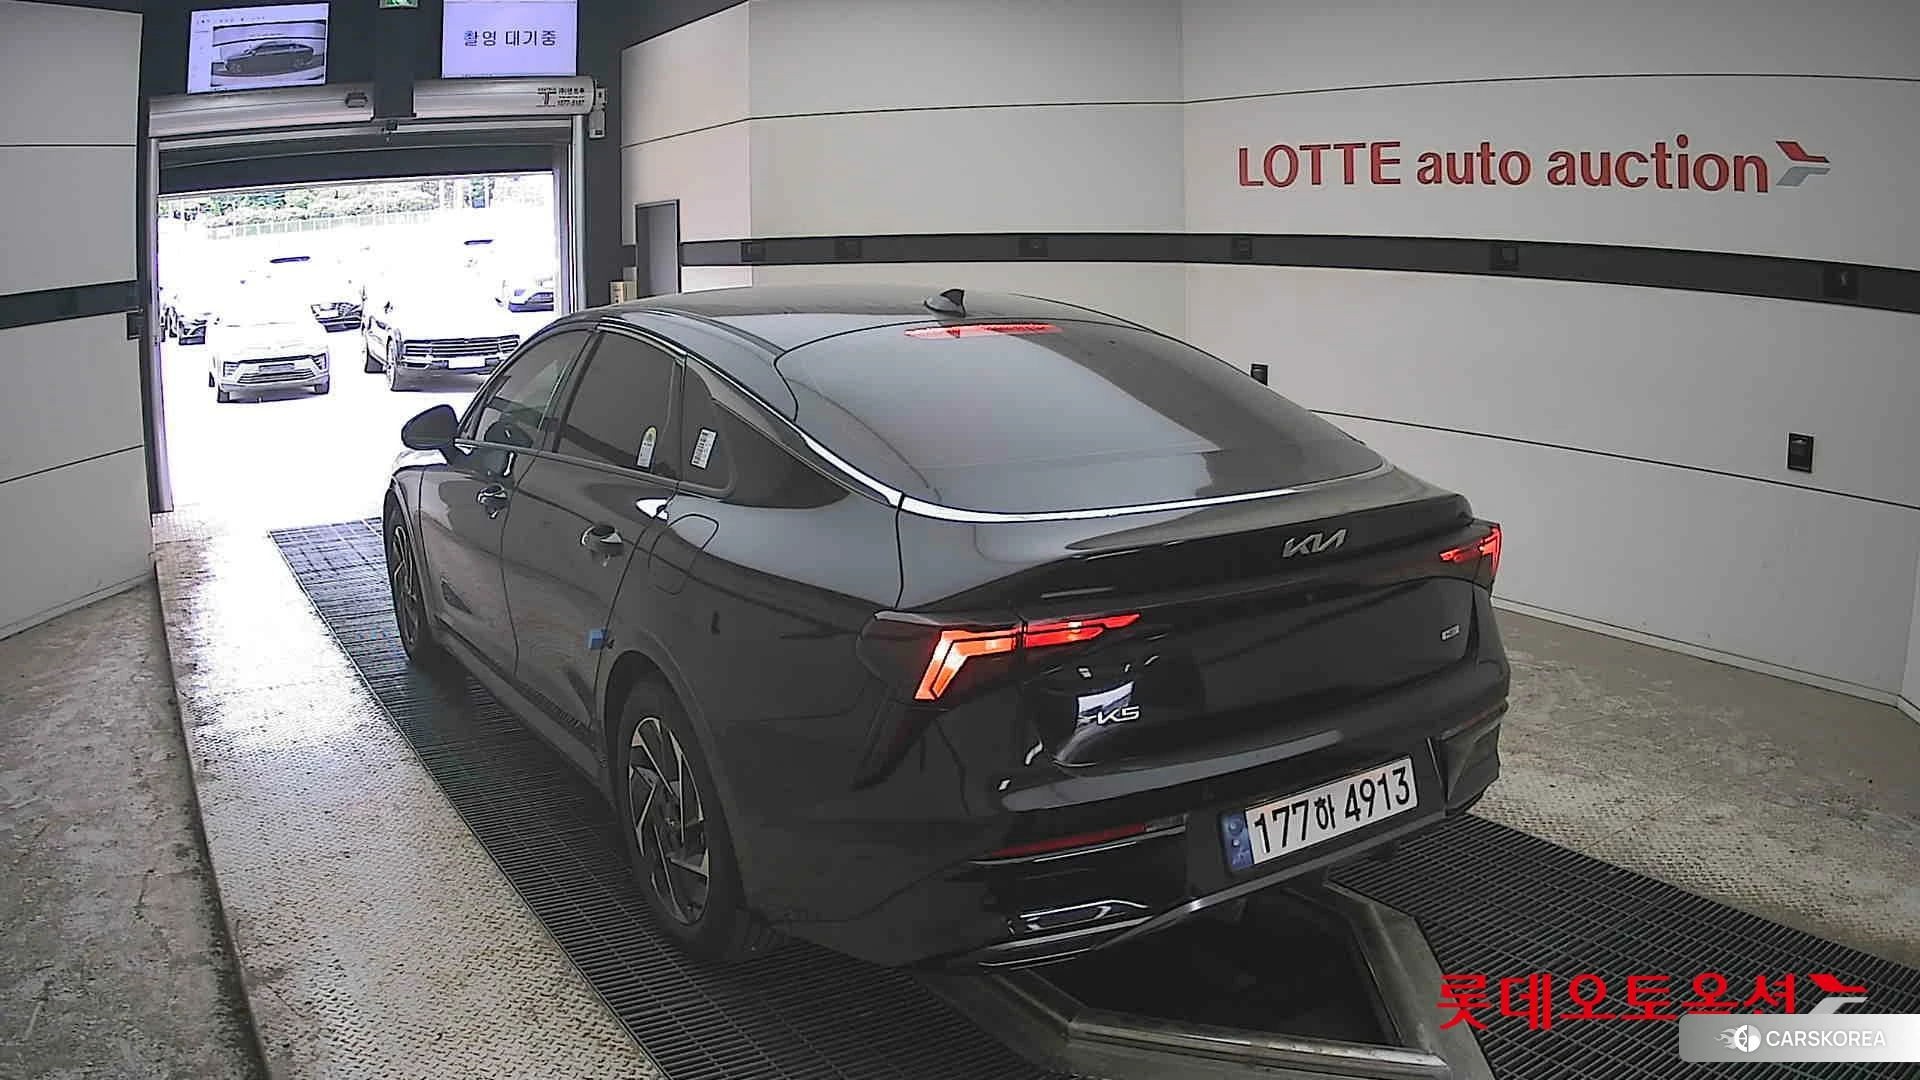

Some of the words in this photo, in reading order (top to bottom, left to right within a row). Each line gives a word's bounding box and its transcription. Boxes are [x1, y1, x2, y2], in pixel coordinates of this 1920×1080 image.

[464, 30, 496, 47] 촬영
[505, 30, 556, 47] 대기중
[1238, 142, 1401, 188] LOTTE
[1416, 141, 1531, 187] auto
[1547, 135, 1769, 193] auction
[1097, 705, 1140, 725] K5
[1254, 795, 1336, 854] 177하
[1344, 766, 1410, 822] 4913
